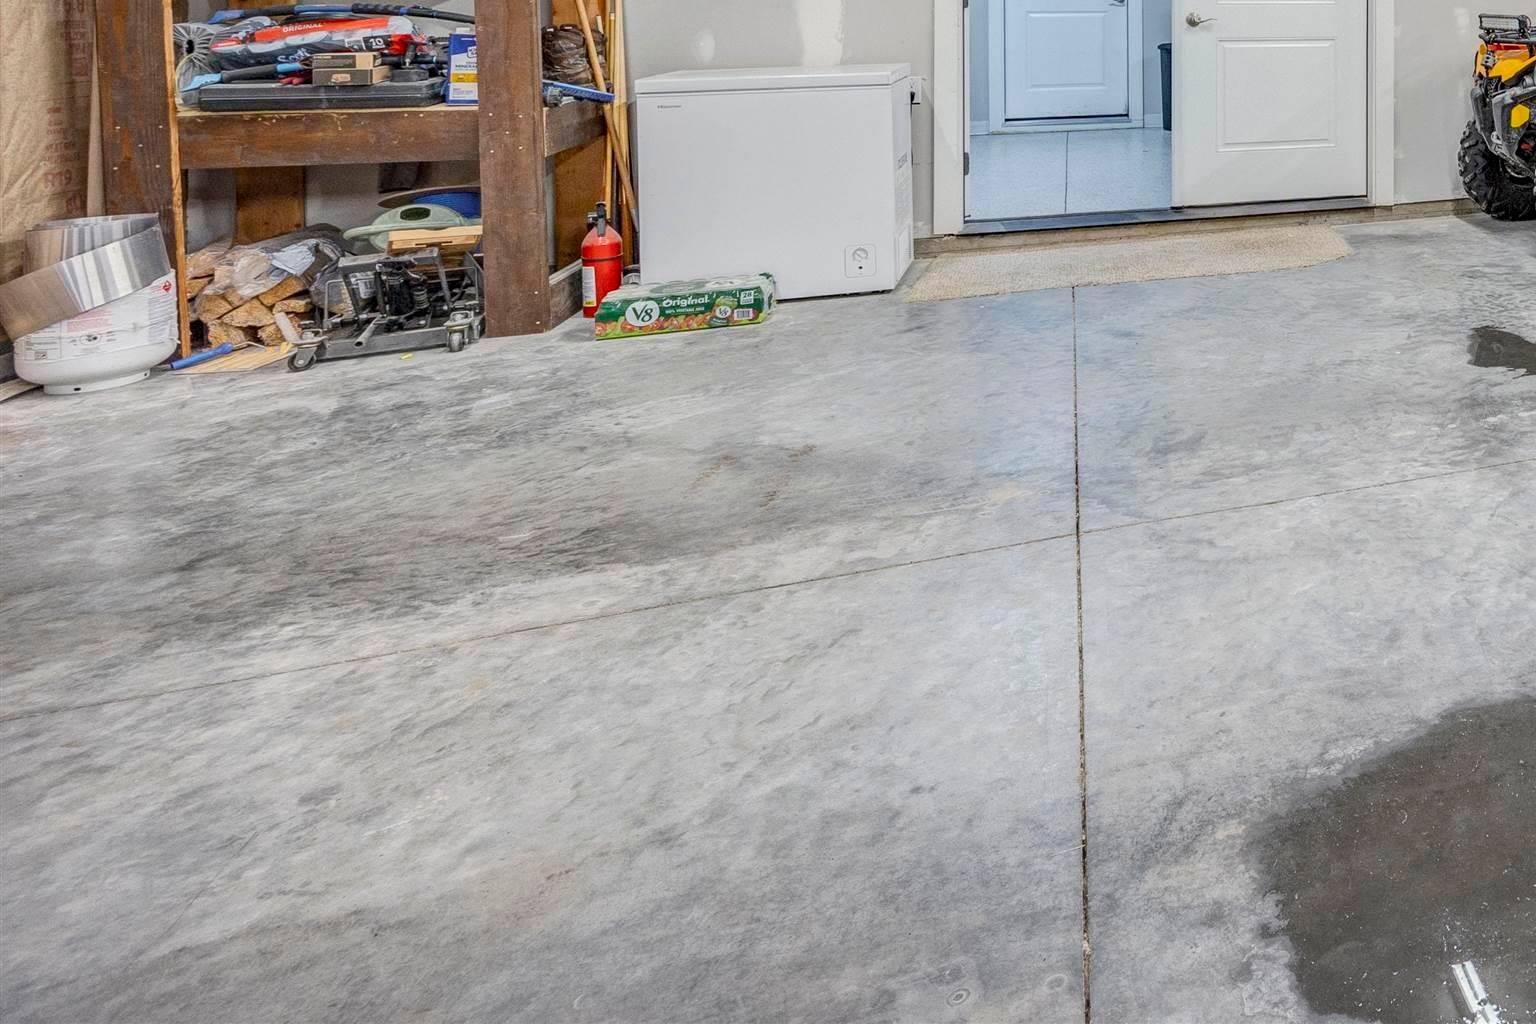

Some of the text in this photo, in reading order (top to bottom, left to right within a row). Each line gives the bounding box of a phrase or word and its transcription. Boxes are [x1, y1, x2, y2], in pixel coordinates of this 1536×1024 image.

[283, 23, 322, 33] ORIGINAL
[369, 37, 383, 49] 10
[662, 294, 710, 308] Original
[631, 305, 654, 323] V8
[718, 307, 730, 317] V8
